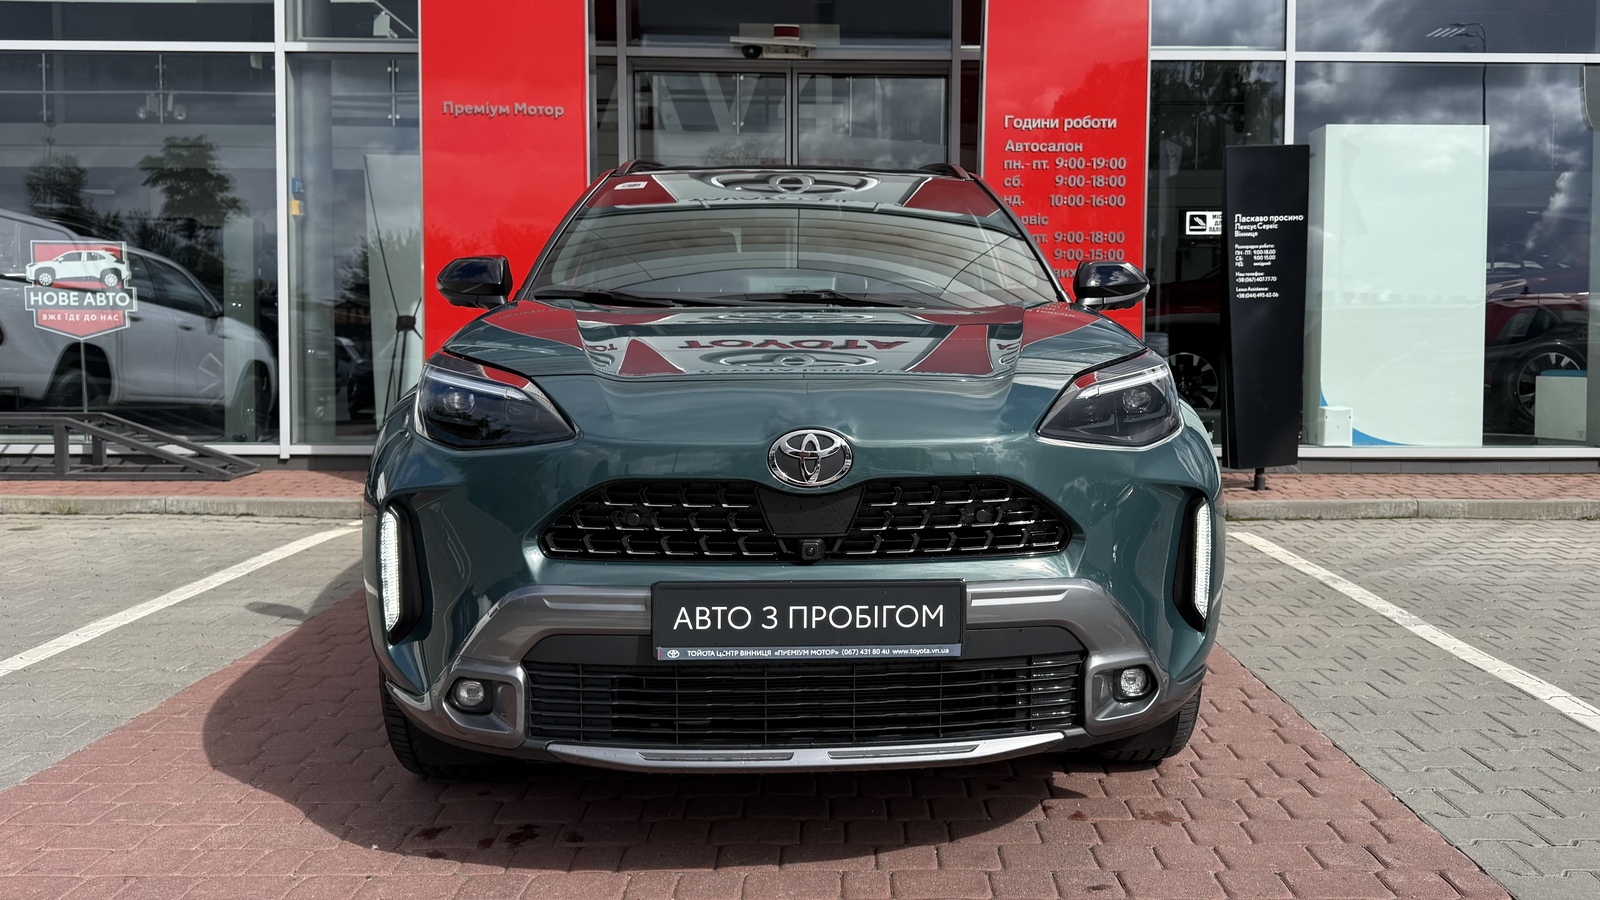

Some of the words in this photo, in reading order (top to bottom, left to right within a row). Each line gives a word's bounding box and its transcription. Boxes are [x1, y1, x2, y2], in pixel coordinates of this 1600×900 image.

[443, 101, 510, 118] Преміум
[514, 103, 565, 119] Мотор
[1004, 115, 1059, 130] Години
[1064, 115, 1117, 132] роботи
[1005, 140, 1083, 152] Автосалон
[1055, 157, 1127, 170] 9:00-19:00
[1004, 175, 1024, 187] сб.
[1055, 175, 1126, 188] 9:00-18:00
[1003, 196, 1025, 207] нд.
[1050, 194, 1126, 207] 10:00-16:00
[1020, 212, 1049, 225] рвіс
[1234, 214, 1268, 223] Ласкаво
[1269, 214, 1304, 223] просимо
[1235, 223, 1257, 231] Лексус
[1054, 231, 1125, 244] 9:00-18:00
[1054, 249, 1125, 261] 9:00-15:00
[30, 291, 79, 306] НОВЕ
[84, 291, 130, 306] АВТО
[65, 313, 78, 321] ЇДЕ
[673, 606, 751, 630] АВТО
[761, 606, 778, 629] З
[789, 604, 944, 629] ПРОБІГОМ
[687, 649, 715, 657] ТОЙОТА
[740, 649, 772, 657] ВІННИЦЯ
[841, 648, 858, 656] (067)
[892, 648, 949, 656] www.toyota.vn.ua
